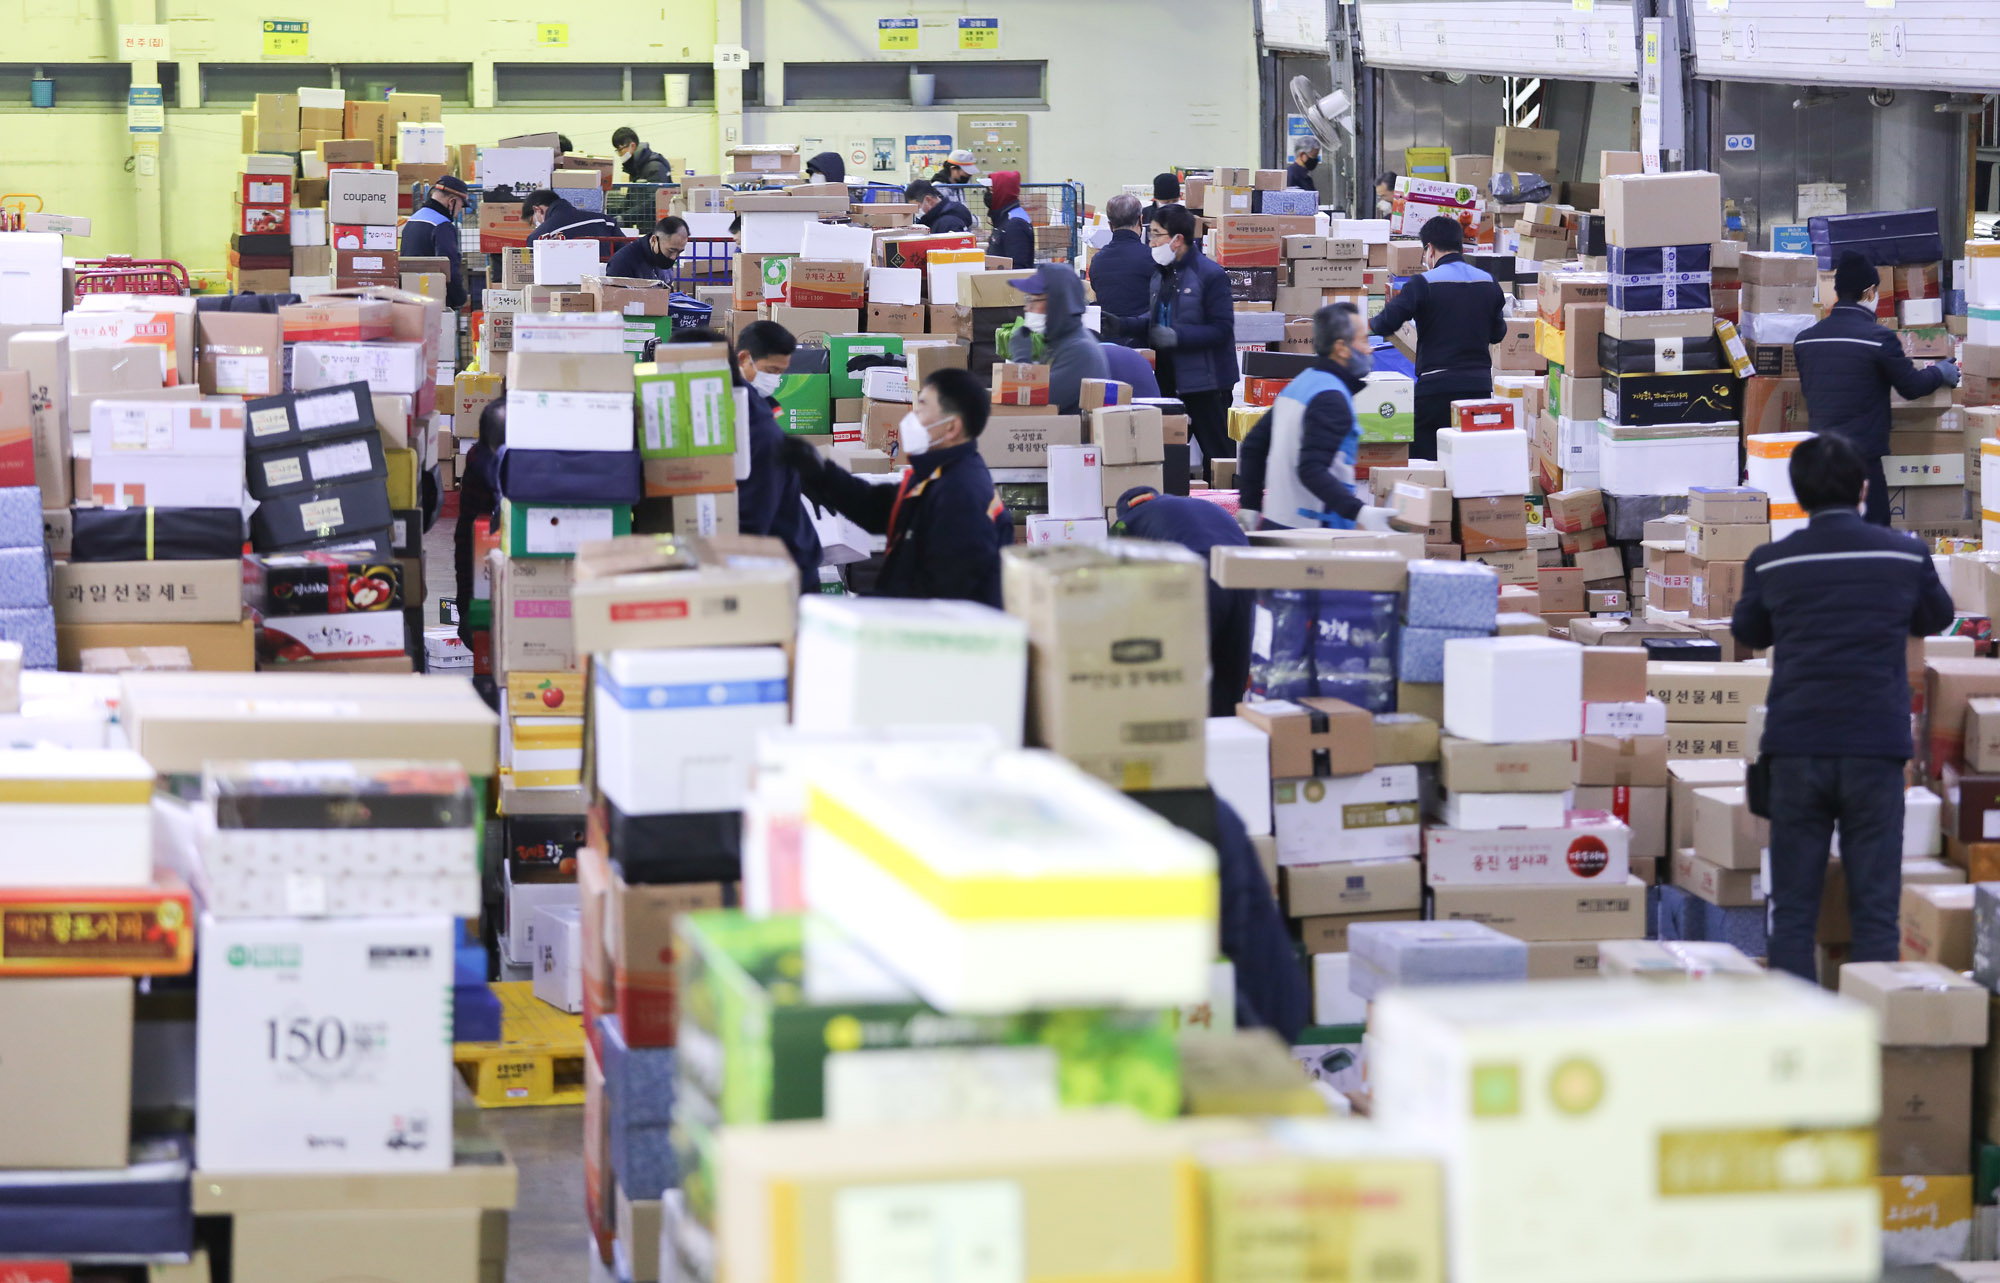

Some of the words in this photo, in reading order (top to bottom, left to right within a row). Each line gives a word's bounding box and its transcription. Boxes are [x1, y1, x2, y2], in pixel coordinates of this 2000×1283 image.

[343, 193, 387, 204] coupang
[1013, 433, 1043, 441] 숙성발효
[268, 1016, 347, 1062] 150
